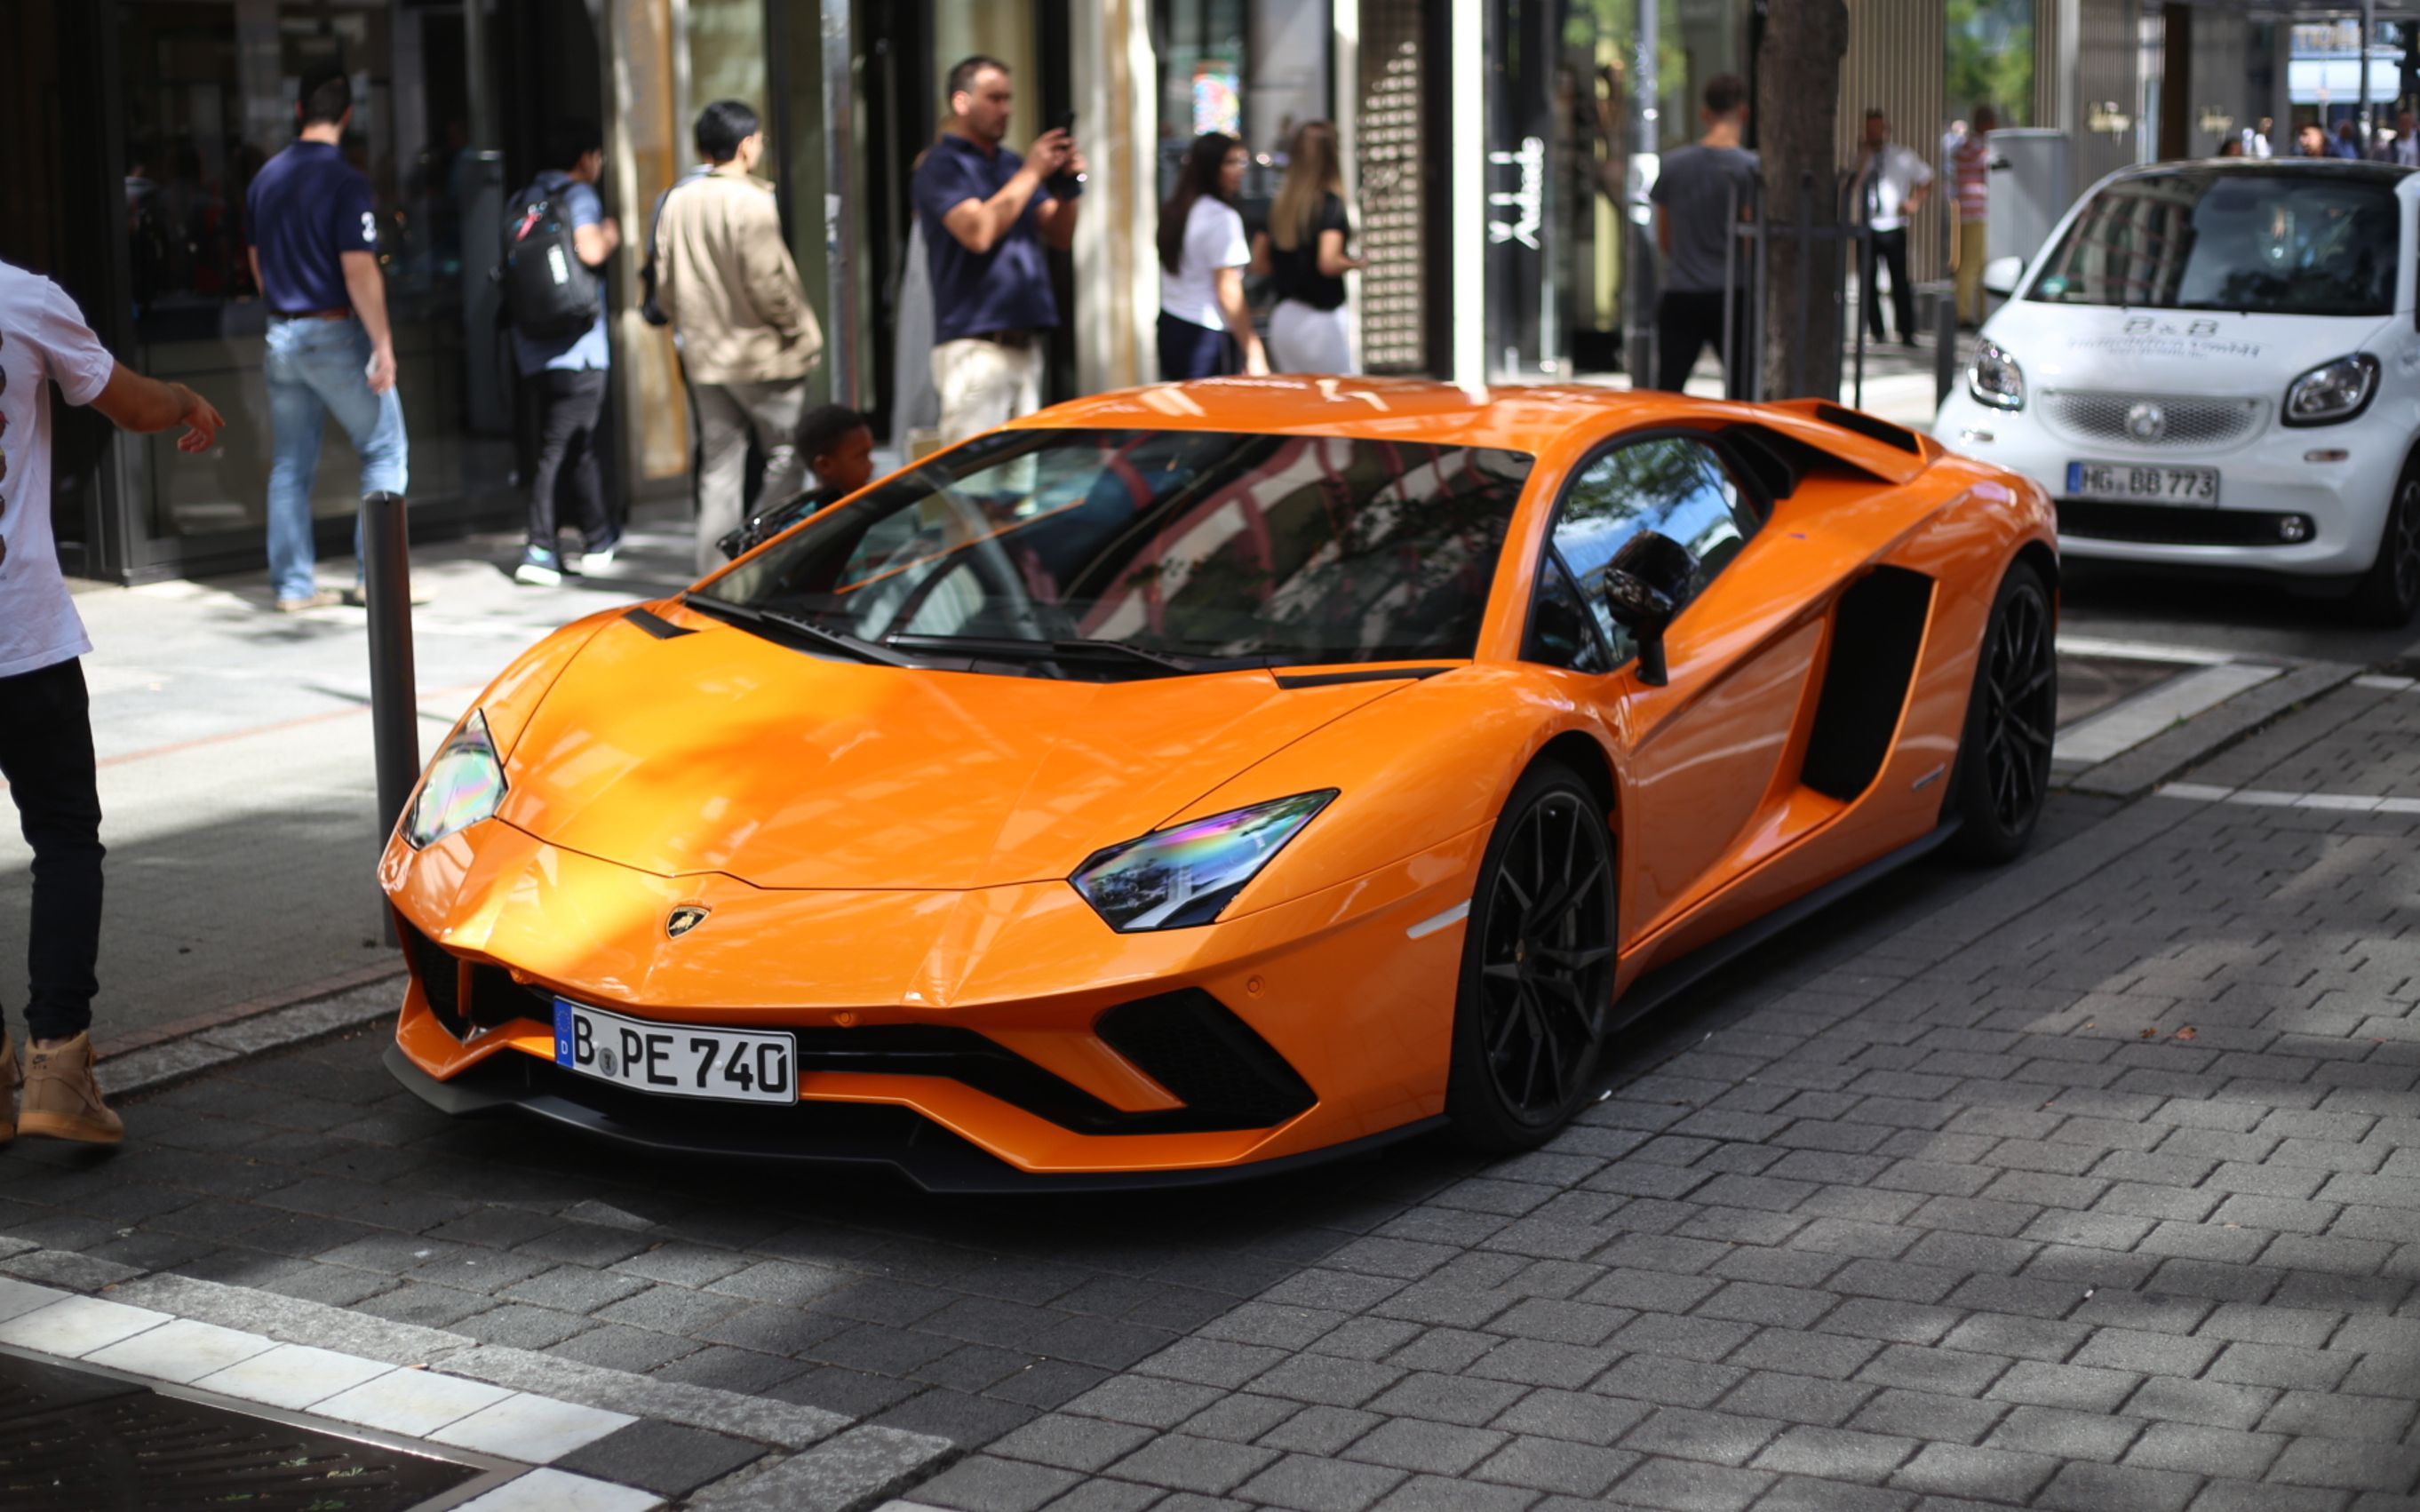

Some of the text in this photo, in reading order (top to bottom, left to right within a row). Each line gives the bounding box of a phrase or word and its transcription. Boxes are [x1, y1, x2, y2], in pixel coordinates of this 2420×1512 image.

[361, 211, 378, 243] 3
[2082, 466, 2214, 497] HG BB 773
[561, 1039, 569, 1055] D
[573, 1014, 788, 1094] B PE 740
